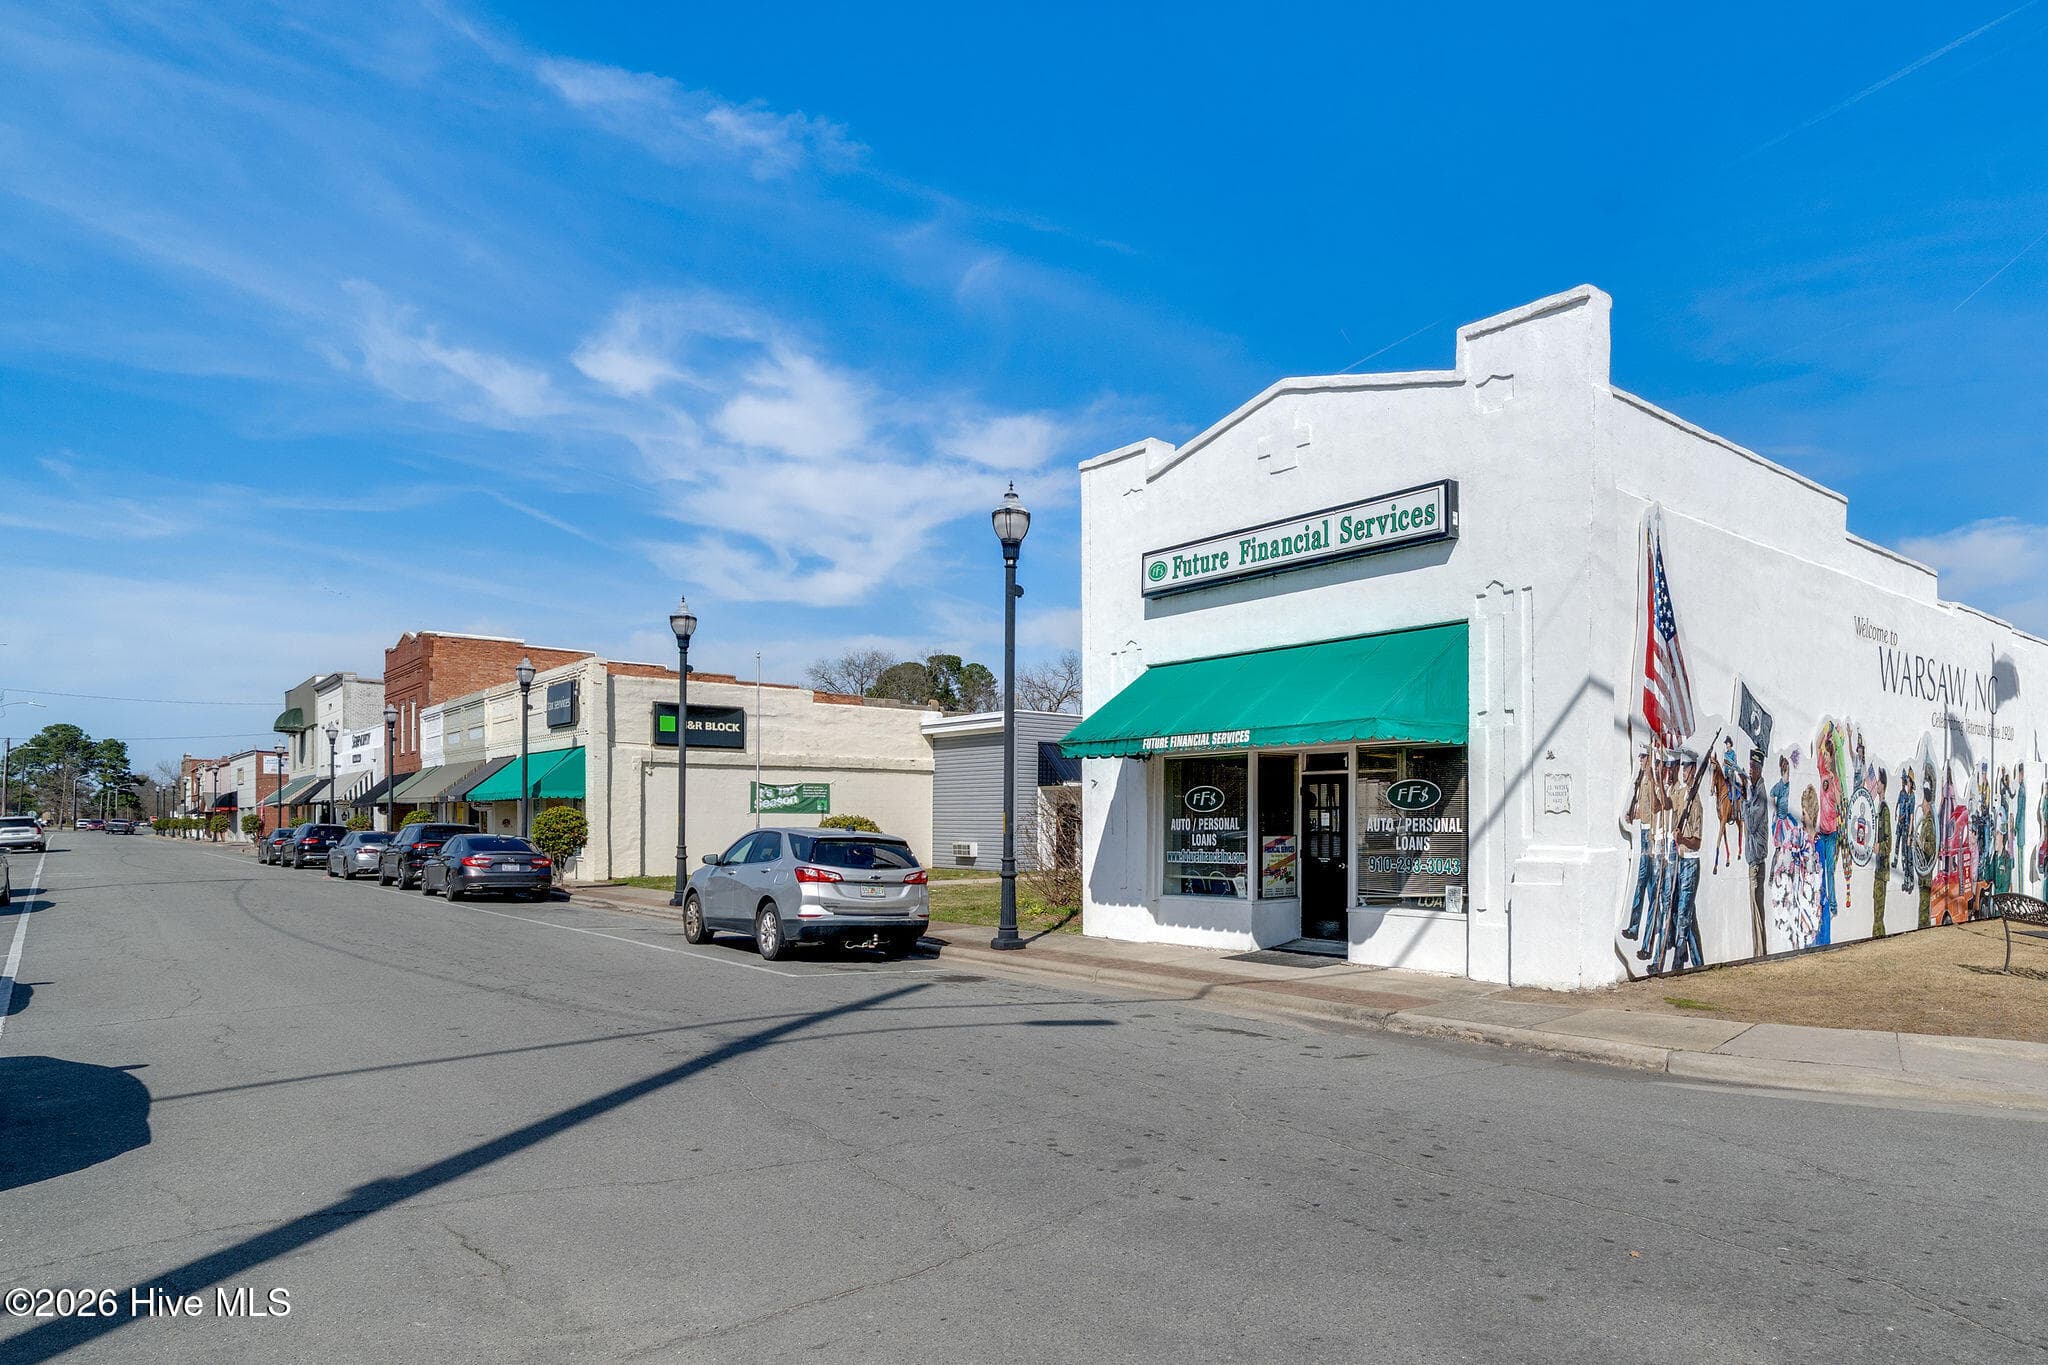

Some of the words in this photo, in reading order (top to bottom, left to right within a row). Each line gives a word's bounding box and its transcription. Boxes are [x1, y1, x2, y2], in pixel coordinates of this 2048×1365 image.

[1172, 550, 1229, 580] Future
[1239, 519, 1330, 566] Financial
[1339, 502, 1437, 545] Services
[1853, 615, 1889, 646] Welcome
[1890, 628, 1899, 647] to
[1878, 646, 1968, 717] WARSAW,
[1975, 671, 1999, 715] NC
[704, 721, 741, 732] BLOCK
[1142, 737, 1169, 750] FUTURE
[1170, 733, 1210, 748] FINANCIAL
[1212, 729, 1251, 745] SERVICES
[1170, 818, 1191, 831] AUTO
[1198, 817, 1240, 831] PERSONAL
[1366, 818, 1394, 832] AUTO
[1405, 817, 1463, 833] PERSONAL
[1191, 833, 1217, 847] LOANS
[1395, 835, 1431, 851] LOANS
[1367, 855, 1462, 876] 910-293-3043
[1417, 894, 1447, 909] LOA
